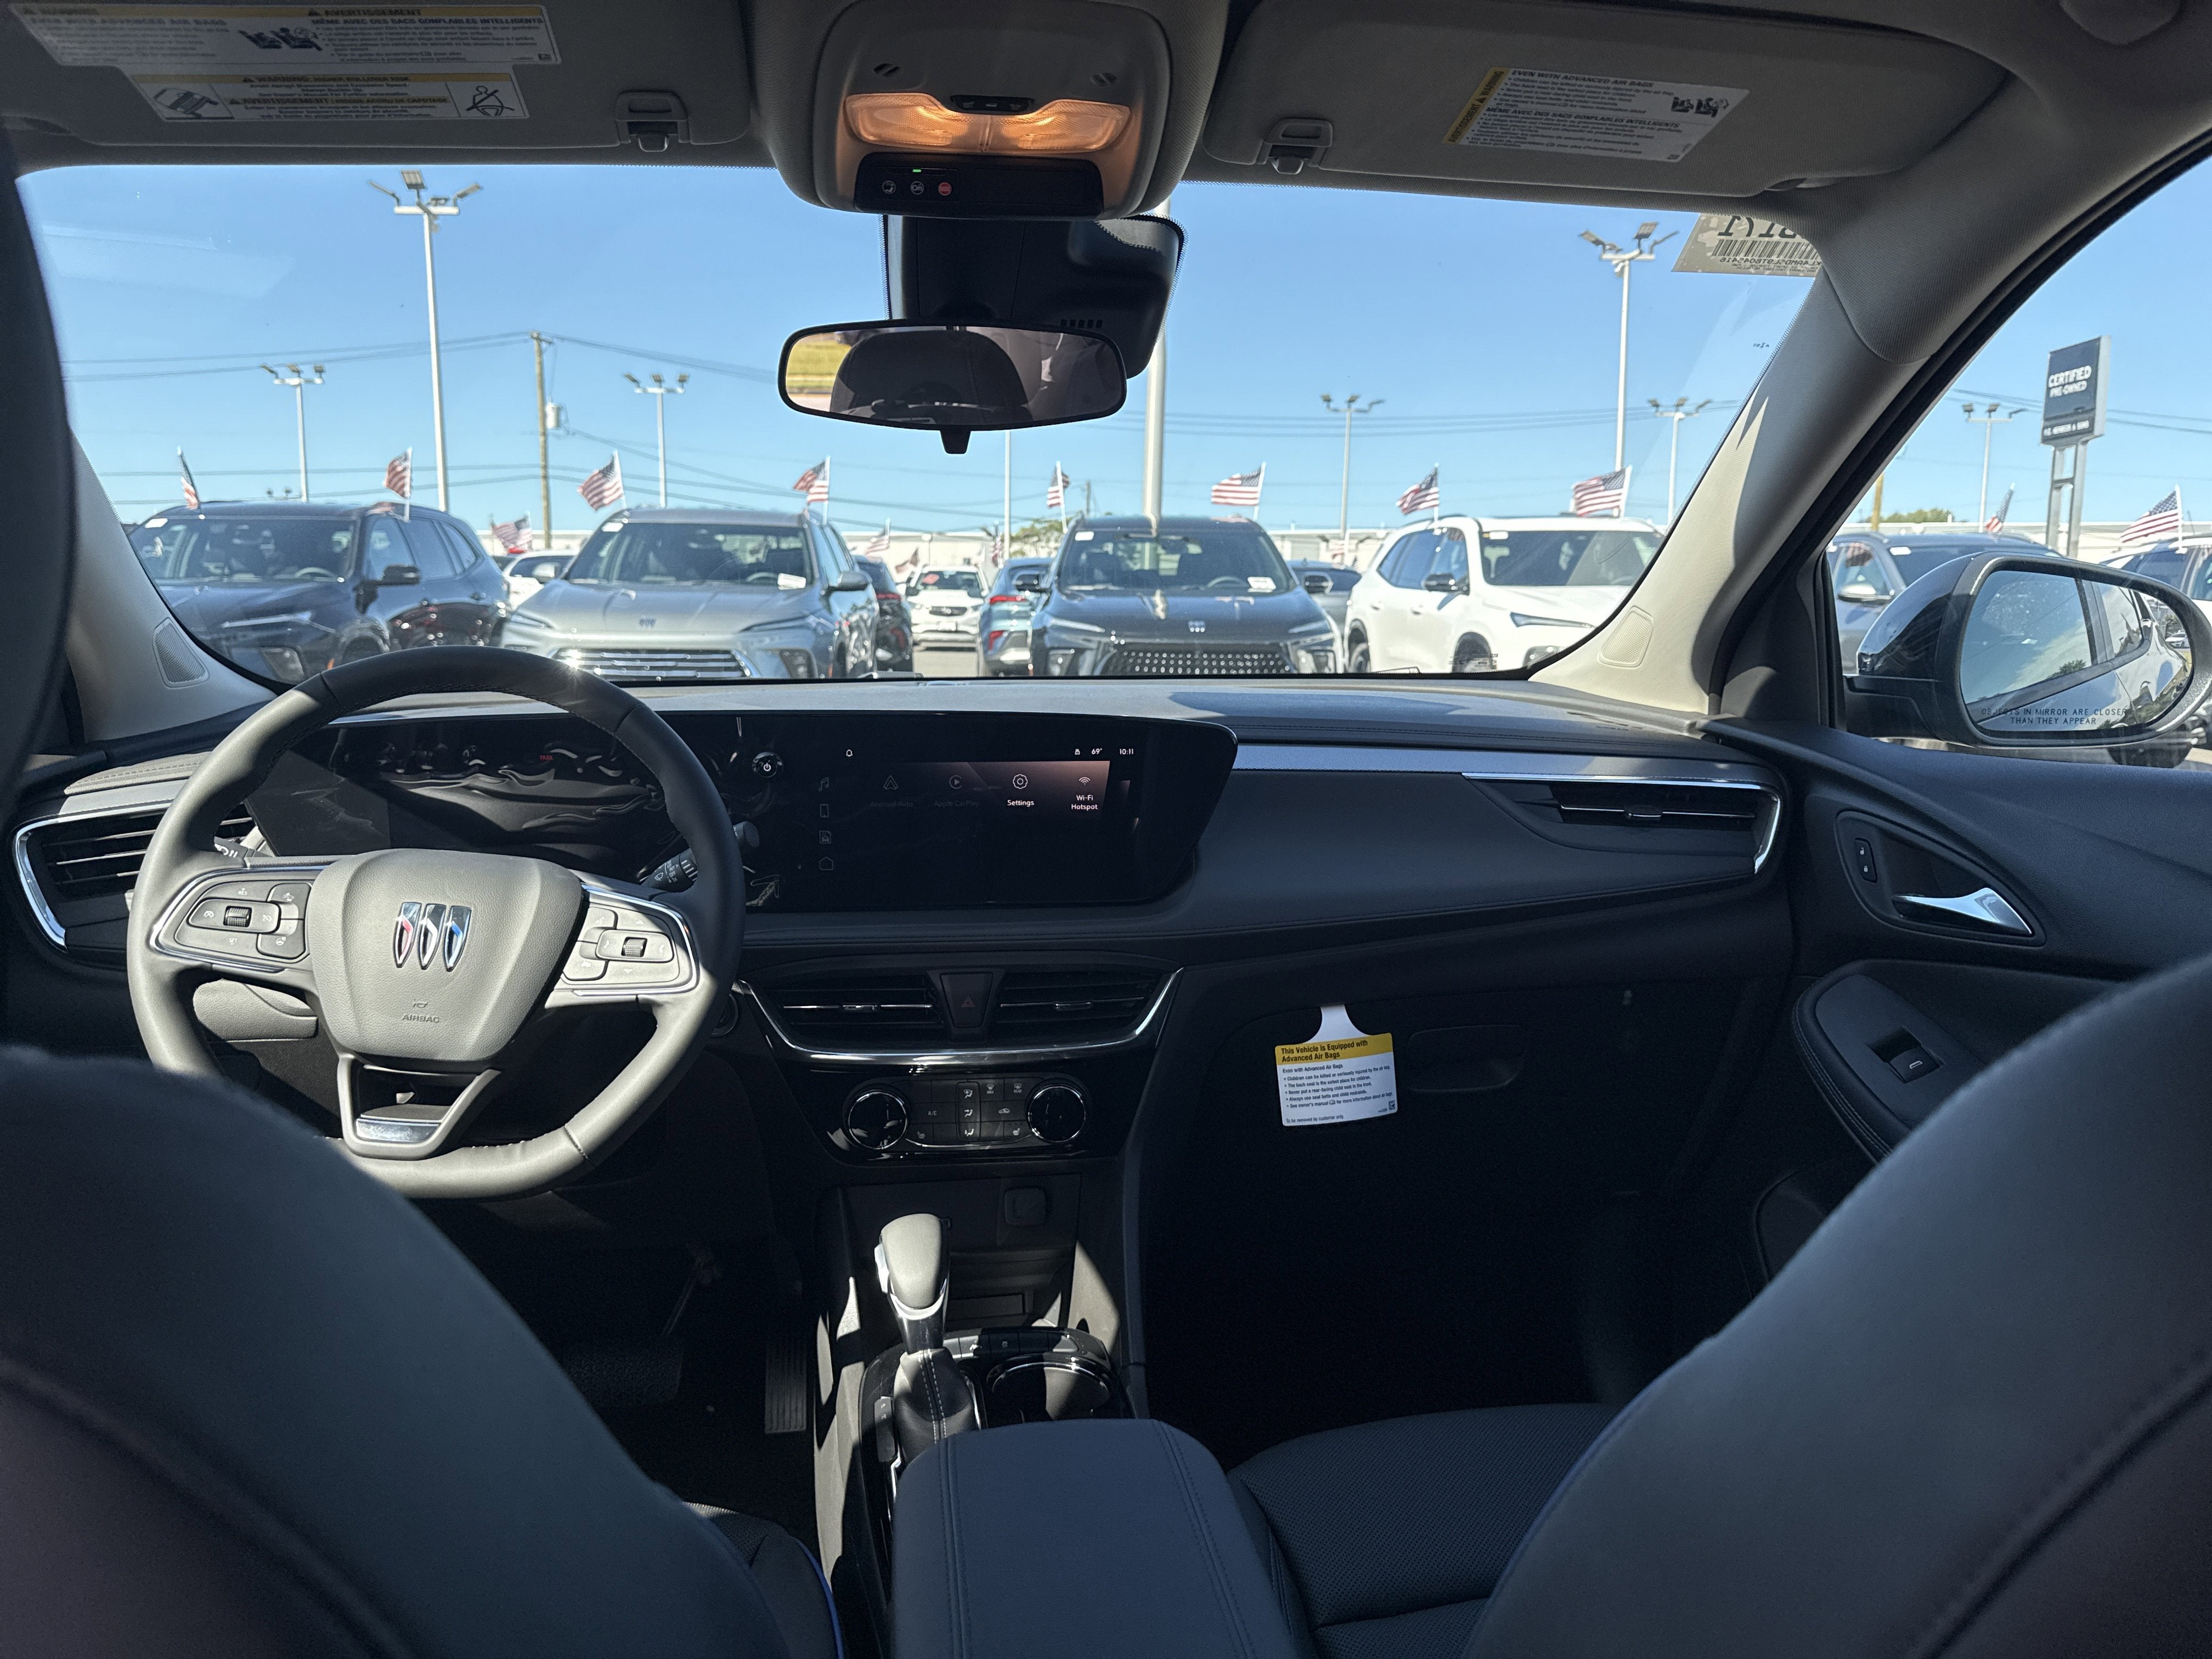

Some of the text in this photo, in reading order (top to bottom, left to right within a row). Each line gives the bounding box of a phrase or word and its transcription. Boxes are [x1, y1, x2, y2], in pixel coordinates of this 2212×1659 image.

[1561, 75, 1610, 83] ADVANCED
[1007, 799, 1035, 808] Settings
[1327, 1041, 1355, 1051] Equipped
[1282, 1054, 1313, 1062] Advanced
